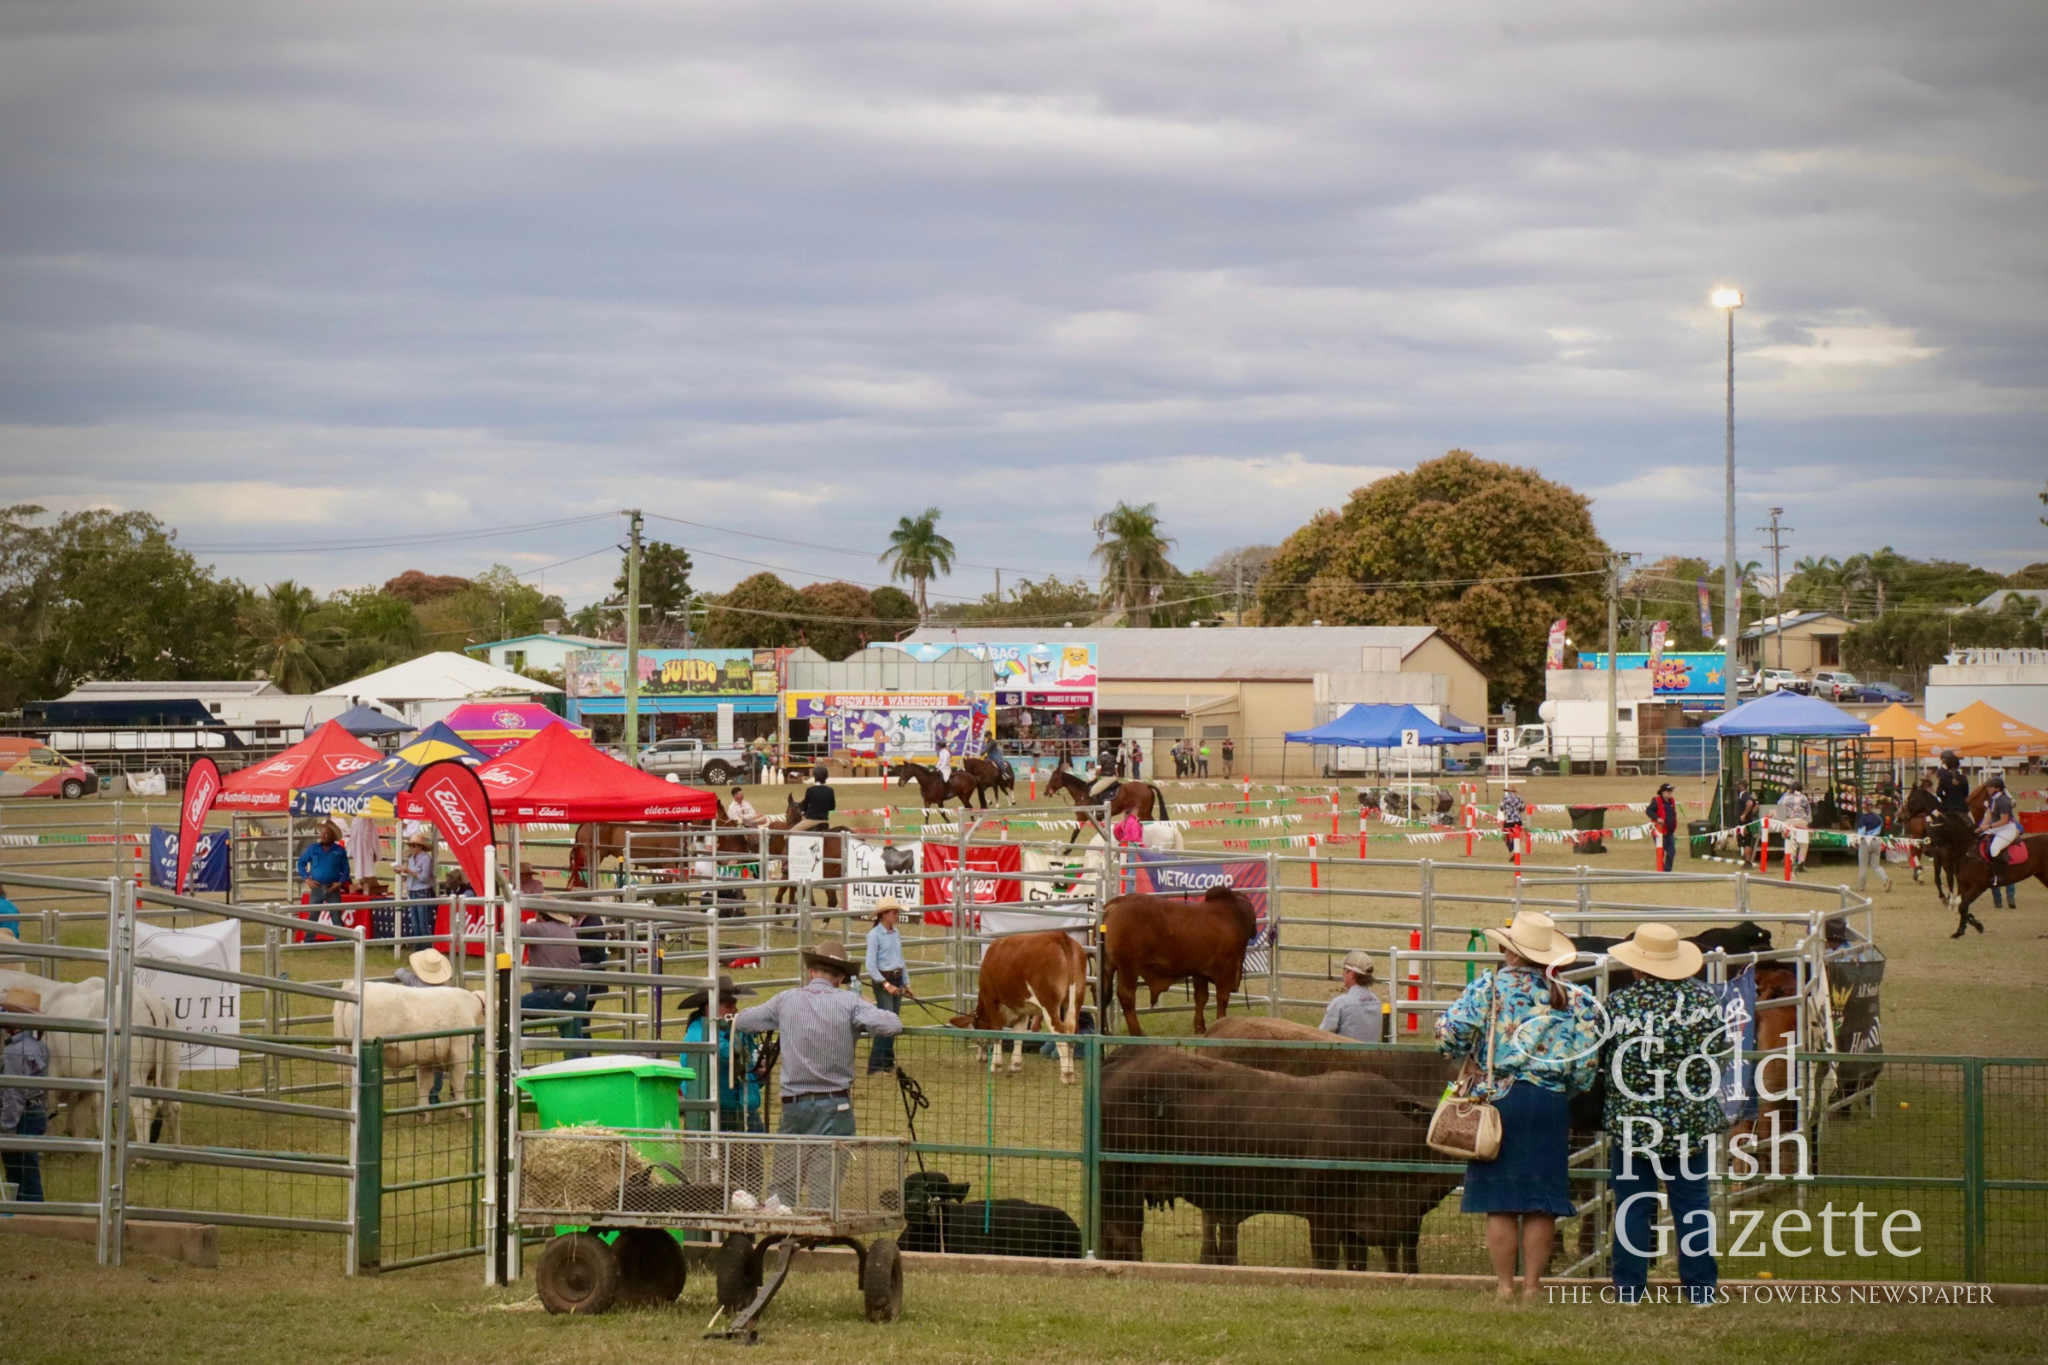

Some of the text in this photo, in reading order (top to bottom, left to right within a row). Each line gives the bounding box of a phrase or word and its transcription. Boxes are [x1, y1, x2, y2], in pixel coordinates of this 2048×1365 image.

[661, 659, 717, 684] JUMBO
[1653, 675, 1690, 688] OOD
[835, 695, 949, 706] SHOWBAG WAREHOUSE
[1406, 731, 1414, 744] 2
[1503, 729, 1510, 742] 3
[313, 796, 371, 814] AGFORCE
[644, 805, 701, 815] elders.com.au
[434, 790, 471, 836] Elders
[538, 807, 565, 817] Elders
[853, 884, 915, 899] HILLVIEW
[174, 995, 236, 1019] UTH
